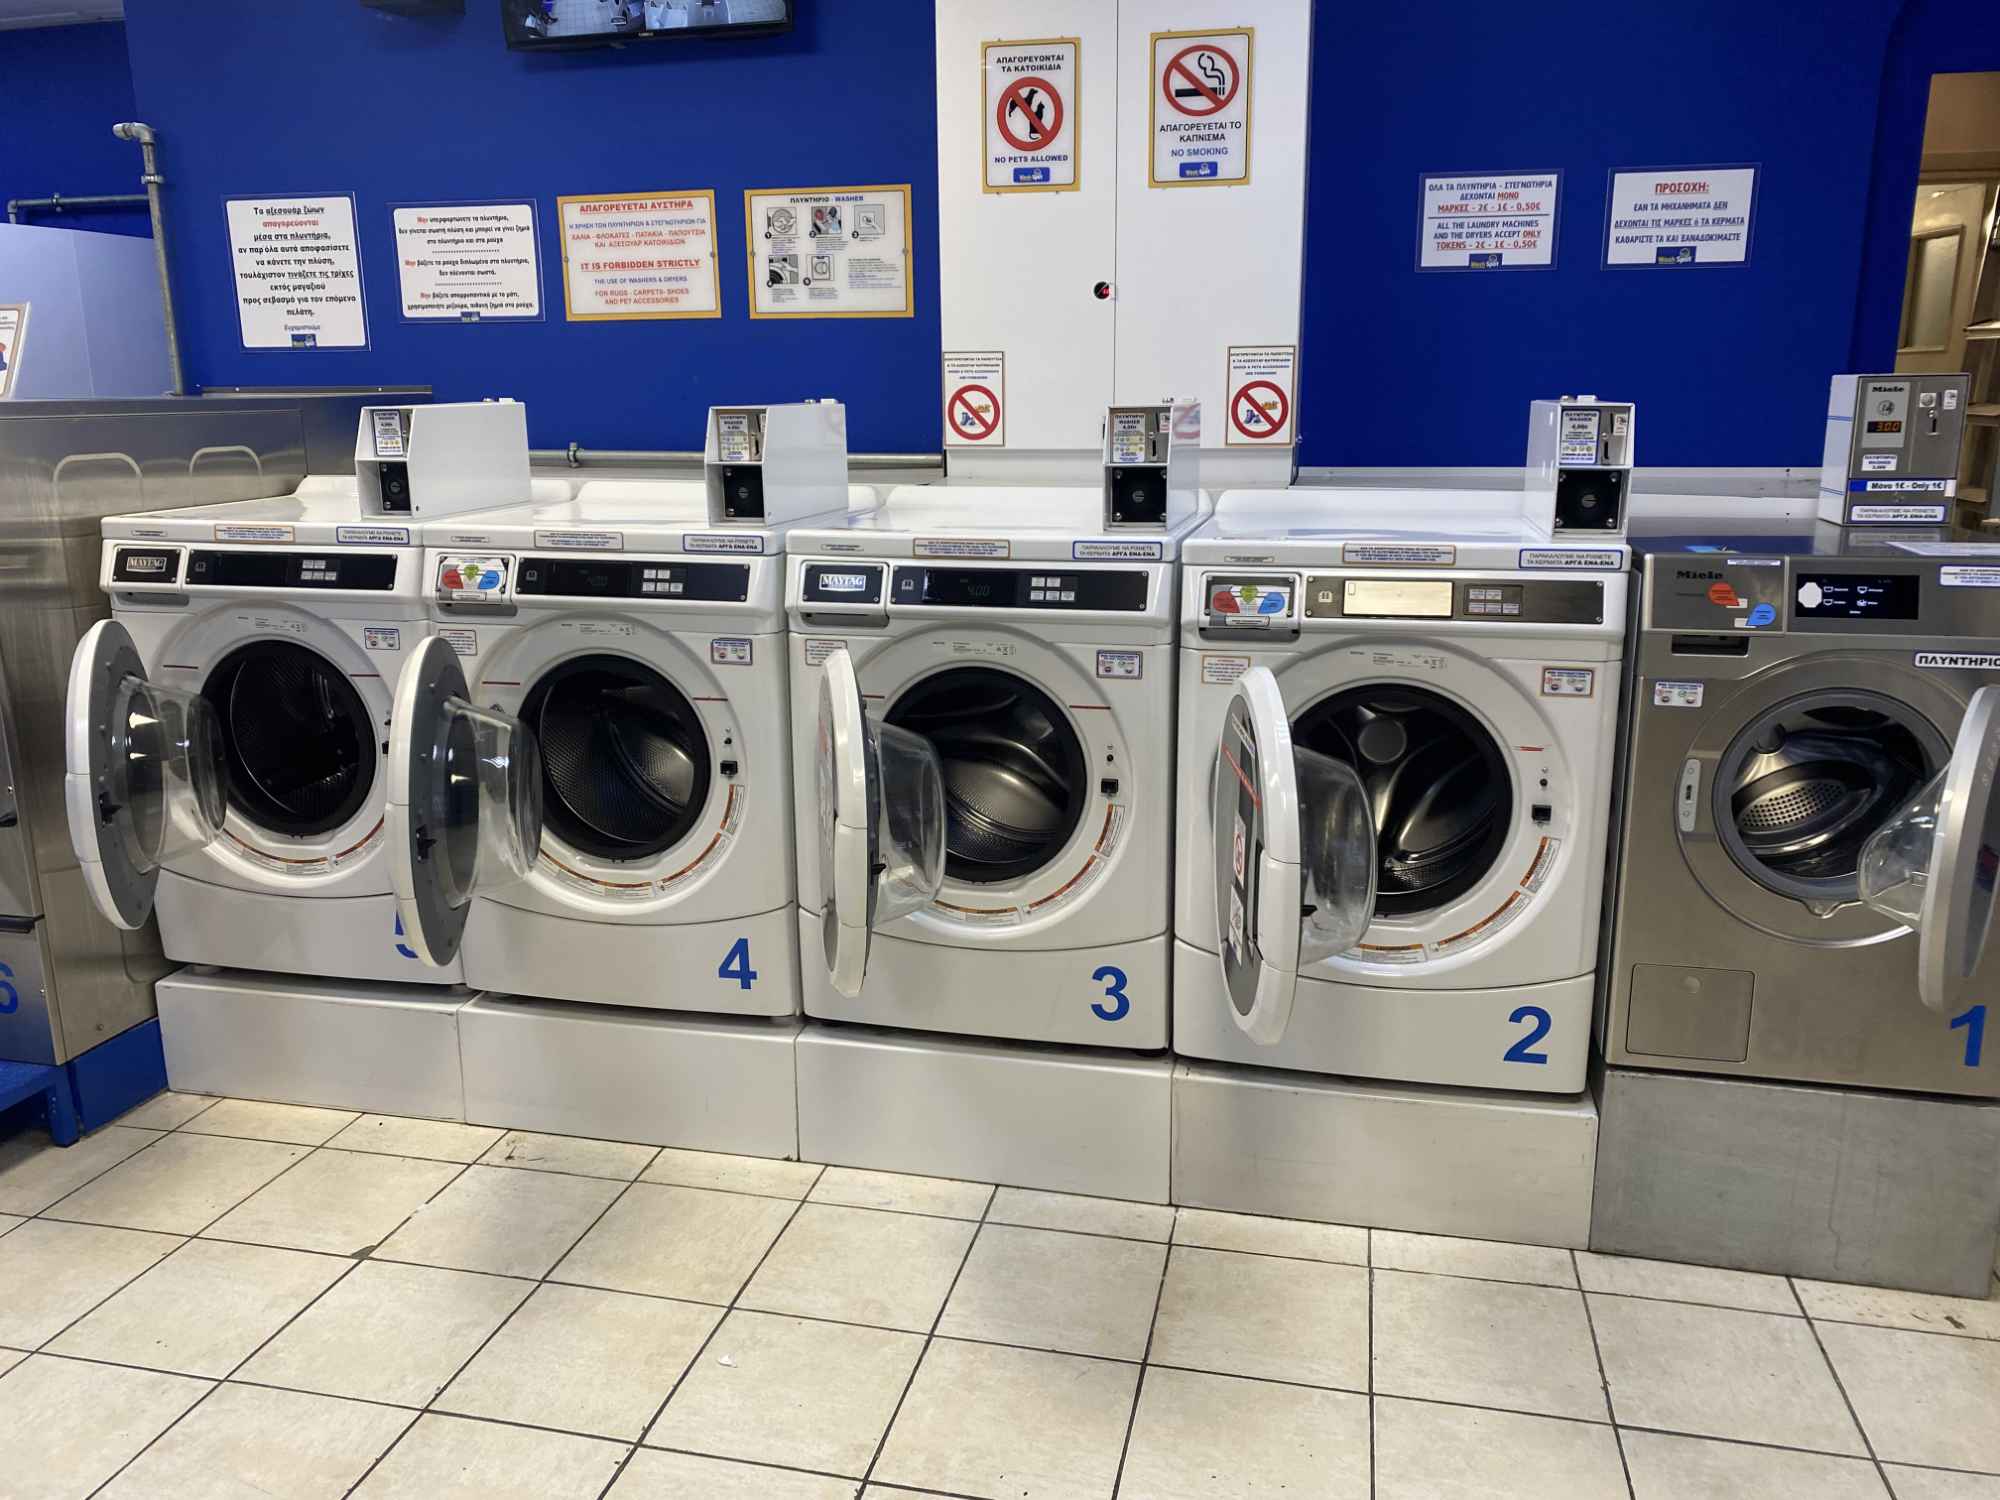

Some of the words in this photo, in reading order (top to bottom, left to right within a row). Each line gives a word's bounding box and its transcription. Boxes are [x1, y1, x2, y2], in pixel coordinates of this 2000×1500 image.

[996, 54, 1064, 64] ΑΠΑΓΟΡΕΥΟΝΤΑΙ
[1014, 64, 1061, 72] ΚΑΤΟΙΚΙΔΙΑ
[1160, 122, 1227, 132] ΑΠΑΓΟΡΕΥΕΤΑΙ
[1230, 121, 1241, 129] ΤΟ
[1179, 134, 1225, 142] ΚΑΠΝΙΣΜΑ
[1171, 149, 1184, 157] NO
[1187, 147, 1228, 156] SMOKING
[1457, 182, 1496, 190] ΠΛΥΝΤΗΡΙΑ
[1505, 181, 1552, 189] ΣΤΕΓΝΩΤΗΡΙΑ
[1655, 182, 1709, 193] ΠΡΟΣΟΧΗ:
[580, 203, 648, 212] ΑΠΑΓΟΡΕΥΕΤΑΙ
[651, 200, 693, 209] ΑΥΣΤΗΡΑ
[1438, 204, 1469, 213] ΜΑΡΚΕΣ
[1498, 203, 1507, 211] 1€
[1634, 203, 1647, 211] ΕΑΝ
[1650, 203, 1659, 211] ΤΑ
[1661, 201, 1711, 210] ΜΗΧΑΝΗΜΑΤΑ
[1713, 201, 1728, 210] ΔΕΝ
[1467, 221, 1500, 229] LAUNDRY
[1615, 219, 1649, 228] ΔΕΧΟΝΤΑΙ
[1651, 219, 1661, 227] ΤΙΣ
[1712, 217, 1744, 225] ΚΕΡΜΑΤΑ
[1615, 235, 1654, 243] ΚΑΘΑΡΙΣΤΕ
[1656, 235, 1664, 243] ΤΑ
[1437, 242, 1466, 250] TOKENS
[603, 260, 654, 269] FORBIDDEN
[657, 259, 700, 268] STRICTLY
[128, 559, 164, 567] MAYTAG
[1676, 570, 1724, 579] Miele
[822, 576, 863, 585] MAYTAG
[720, 939, 757, 990] 4
[1092, 966, 1130, 1021] 3
[1503, 1006, 1551, 1064] 2
[1951, 1005, 1987, 1067] 1
